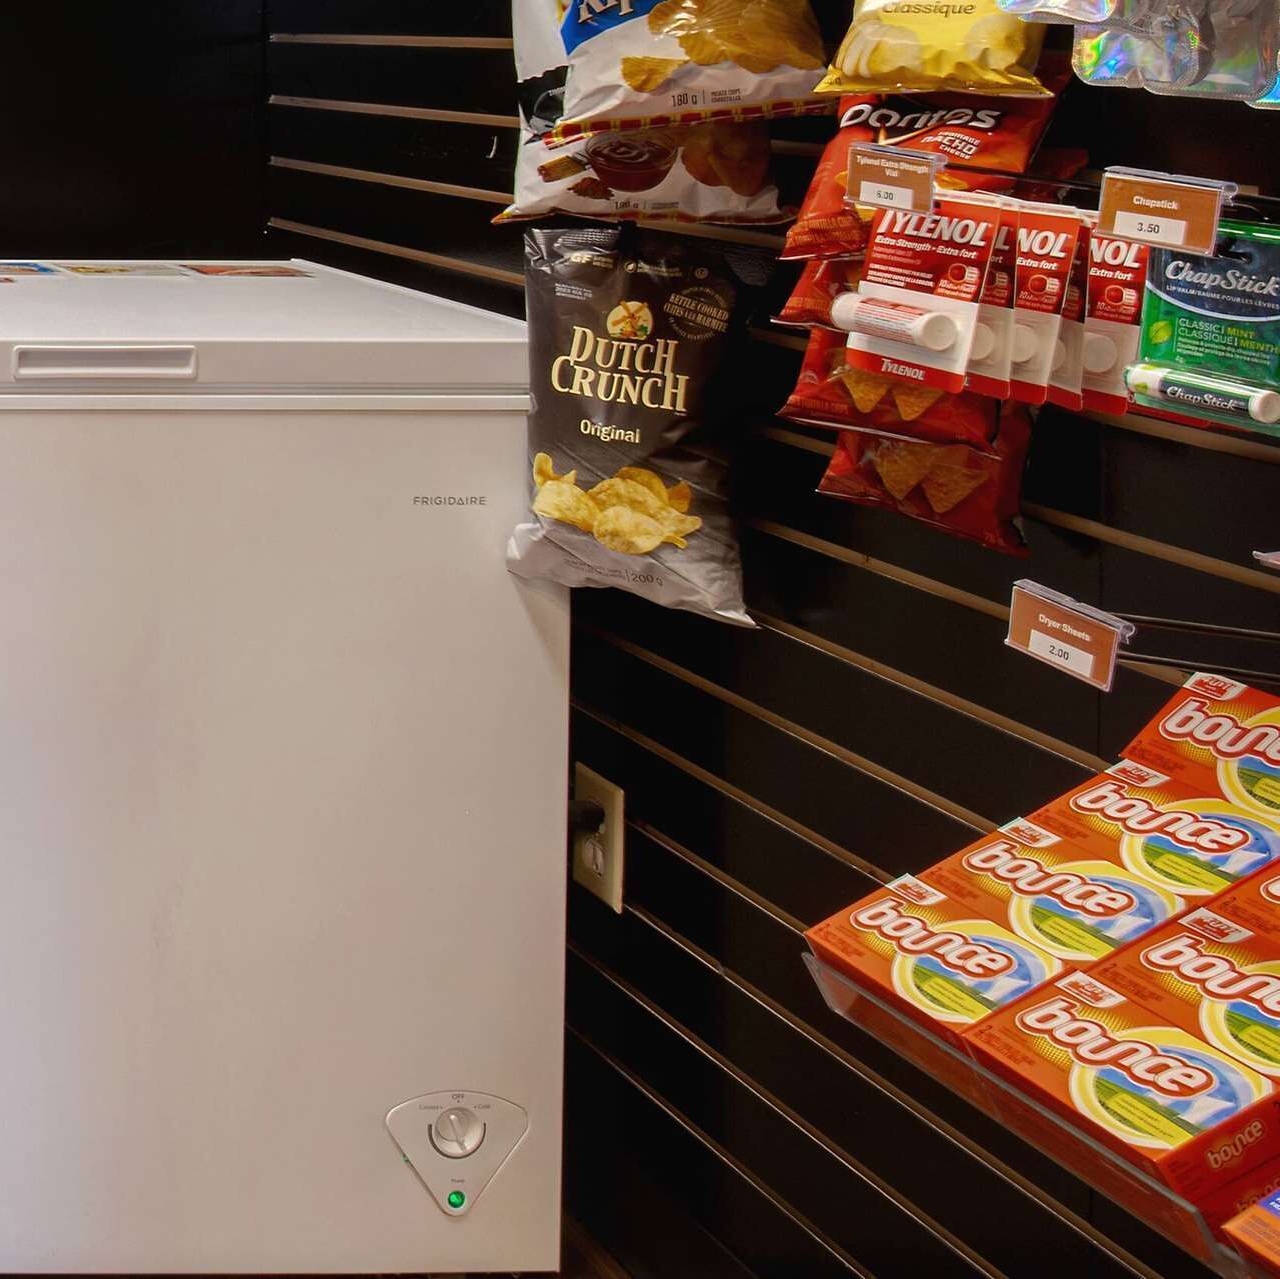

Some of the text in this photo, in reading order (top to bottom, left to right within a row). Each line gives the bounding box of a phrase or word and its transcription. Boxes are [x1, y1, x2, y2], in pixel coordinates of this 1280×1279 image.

[882, 0, 977, 18] Classique
[670, 91, 688, 107] 180
[840, 102, 1003, 131] Doritos
[1132, 194, 1180, 210] Chapstick
[876, 209, 991, 248] TYLENOL
[1136, 221, 1161, 236] 3.50
[874, 234, 978, 259] Extra Strength Extra fort
[1165, 260, 1280, 298] ChapStick
[1177, 327, 1234, 346] CLASSIQUE
[1178, 317, 1256, 339] CLASSIC MINT
[570, 325, 679, 377] DUTCH
[881, 357, 925, 381] TYLENOL
[551, 355, 690, 413] CRUNCH
[1166, 385, 1238, 411] ChapStick
[580, 419, 641, 444] Original
[413, 496, 487, 505] FRIGIDAIRE
[1038, 613, 1091, 642] Dryer Sheets
[1048, 644, 1070, 662] 2.00
[1071, 781, 1249, 854] bounce
[962, 840, 1137, 918] bounce
[851, 897, 1018, 978] bounce
[1015, 995, 1218, 1100] bounce
[1205, 1117, 1266, 1170] bounce
